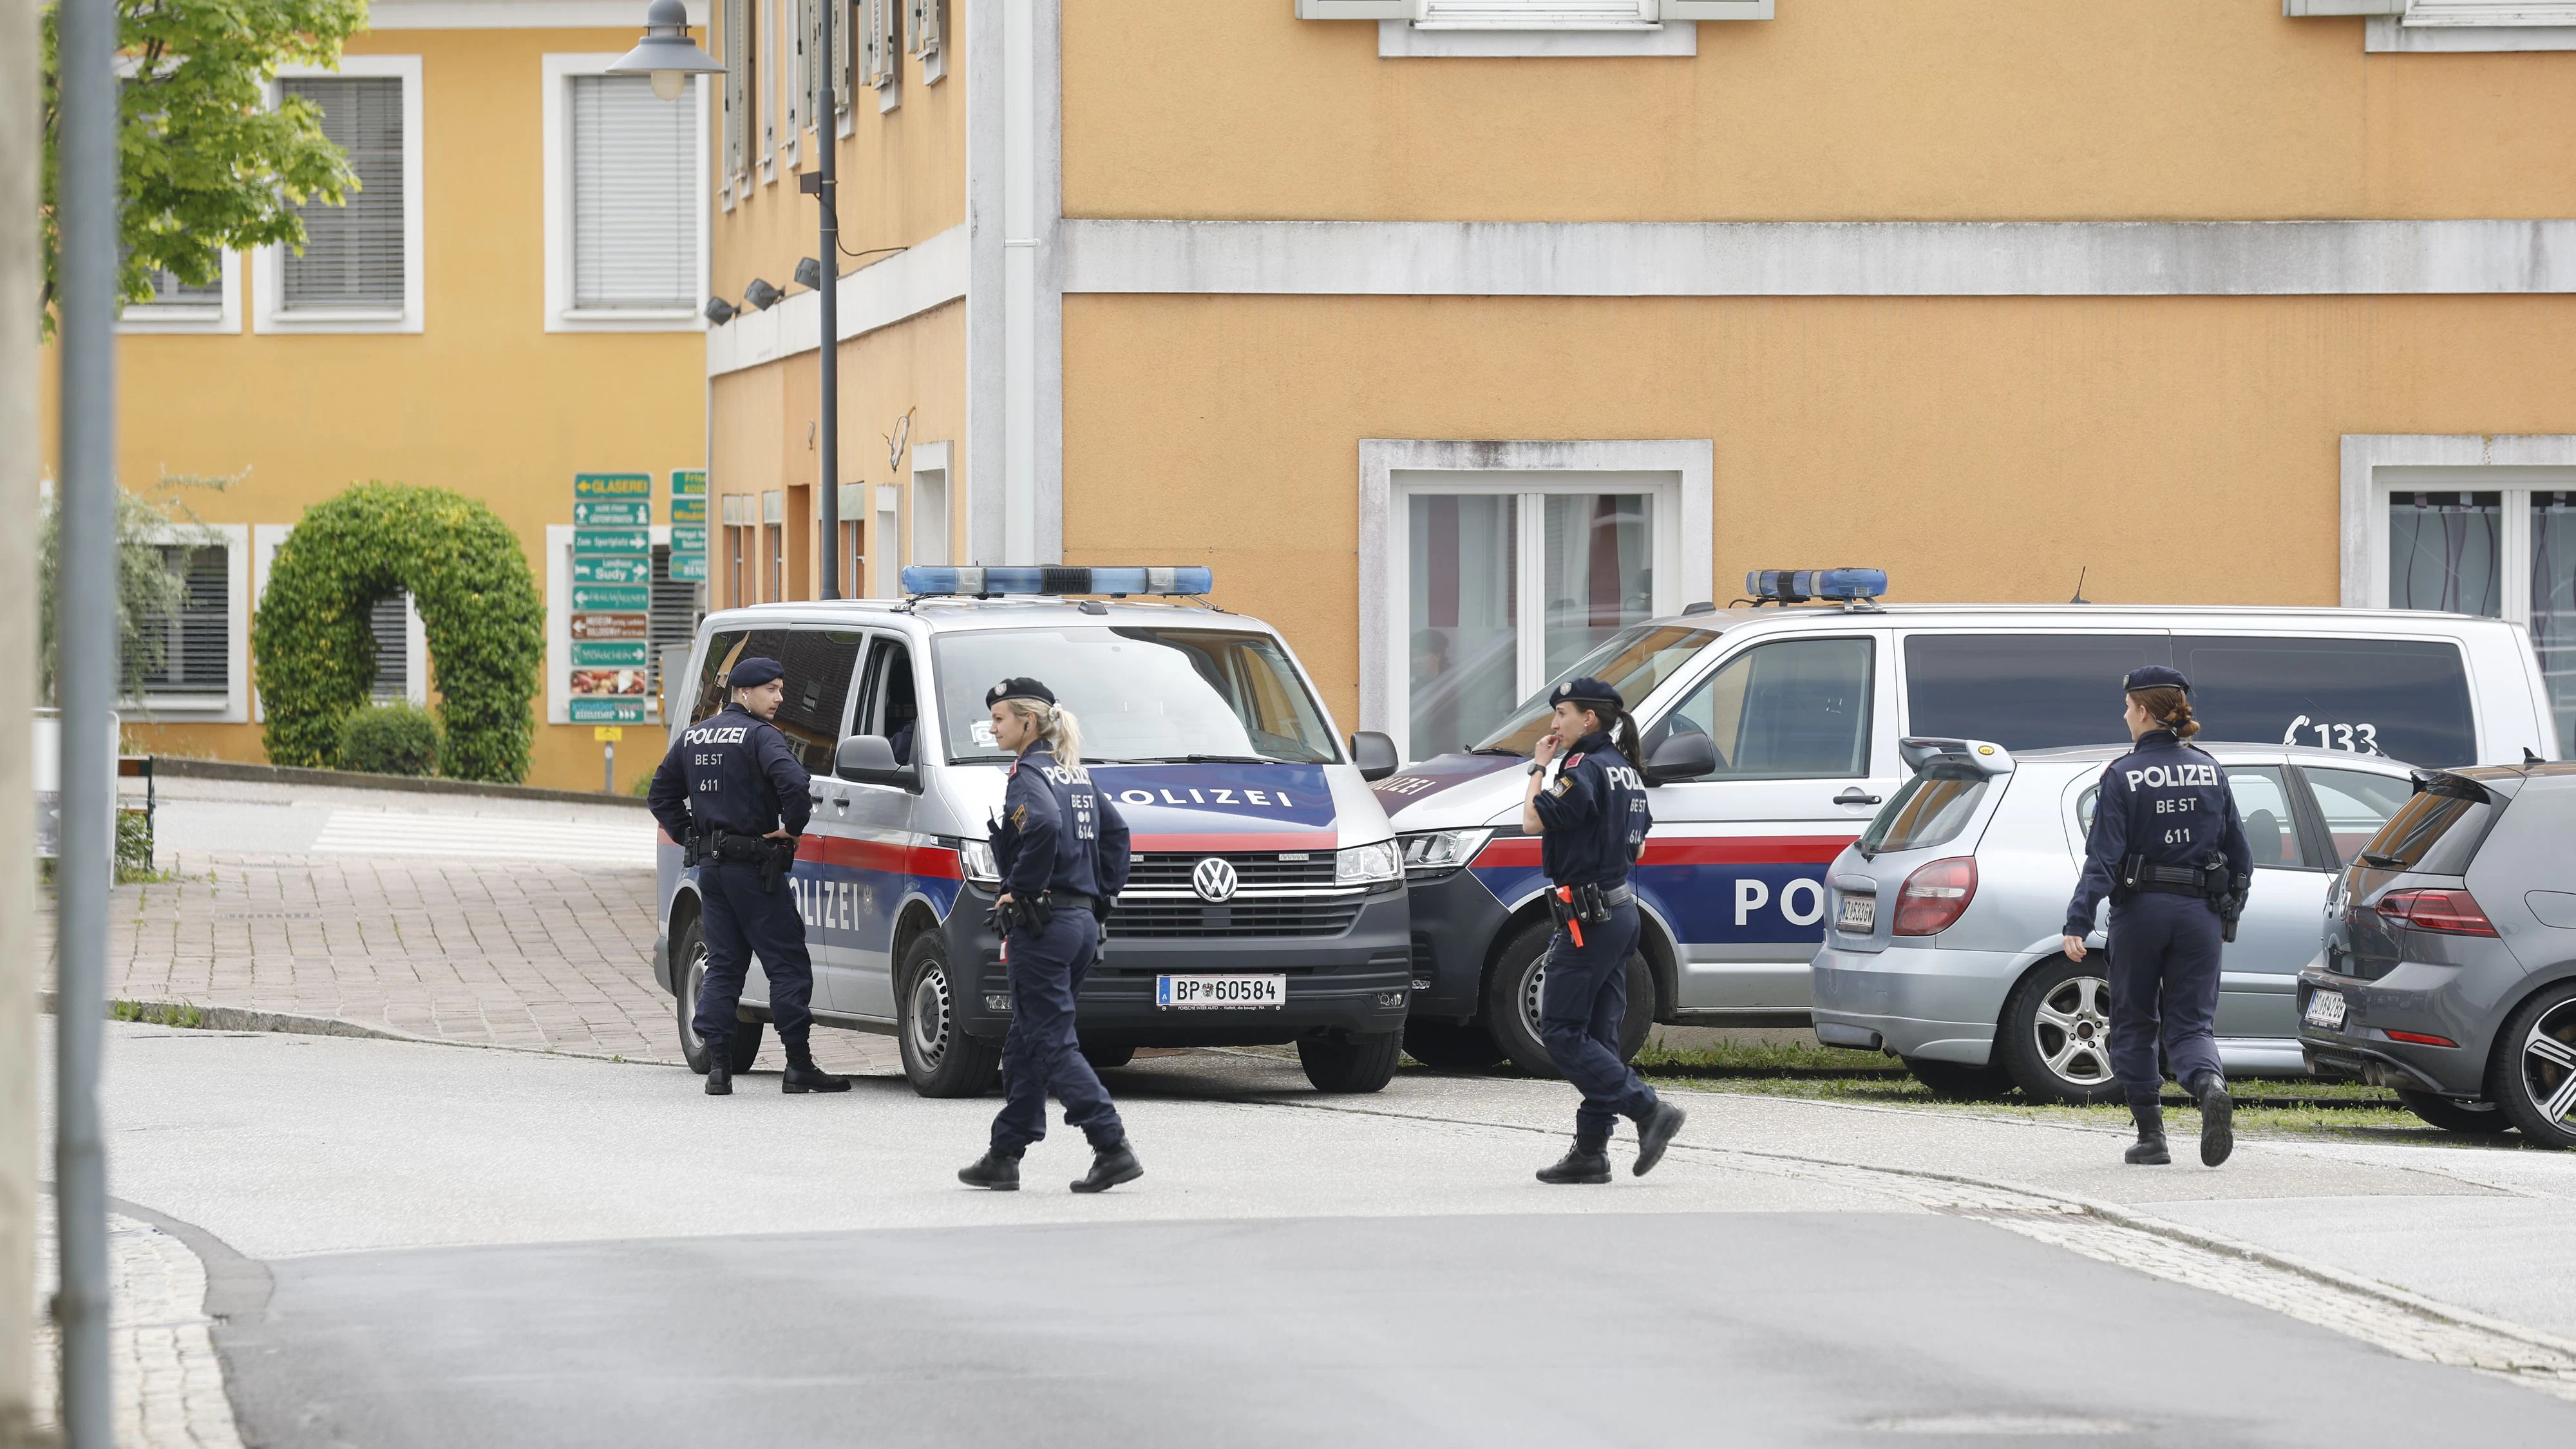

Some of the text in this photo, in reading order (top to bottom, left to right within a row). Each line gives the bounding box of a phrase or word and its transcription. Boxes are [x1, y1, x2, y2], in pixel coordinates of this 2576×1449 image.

[592, 480, 648, 493] GLASEREI
[576, 537, 591, 546] Zum
[595, 567, 627, 580] Sudy
[684, 727, 747, 748] POLIZEI
[2314, 723, 2378, 756] 133
[696, 753, 723, 765] BE ST
[700, 779, 717, 791] 611
[2126, 764, 2219, 792] POLIZEI
[1103, 788, 1293, 807] OLIZEI
[2156, 797, 2197, 814] BE ST
[1078, 825, 1094, 840] 614
[2164, 828, 2190, 844] 611
[1177, 981, 1200, 1000] BP
[1216, 981, 1276, 1000] 60584
